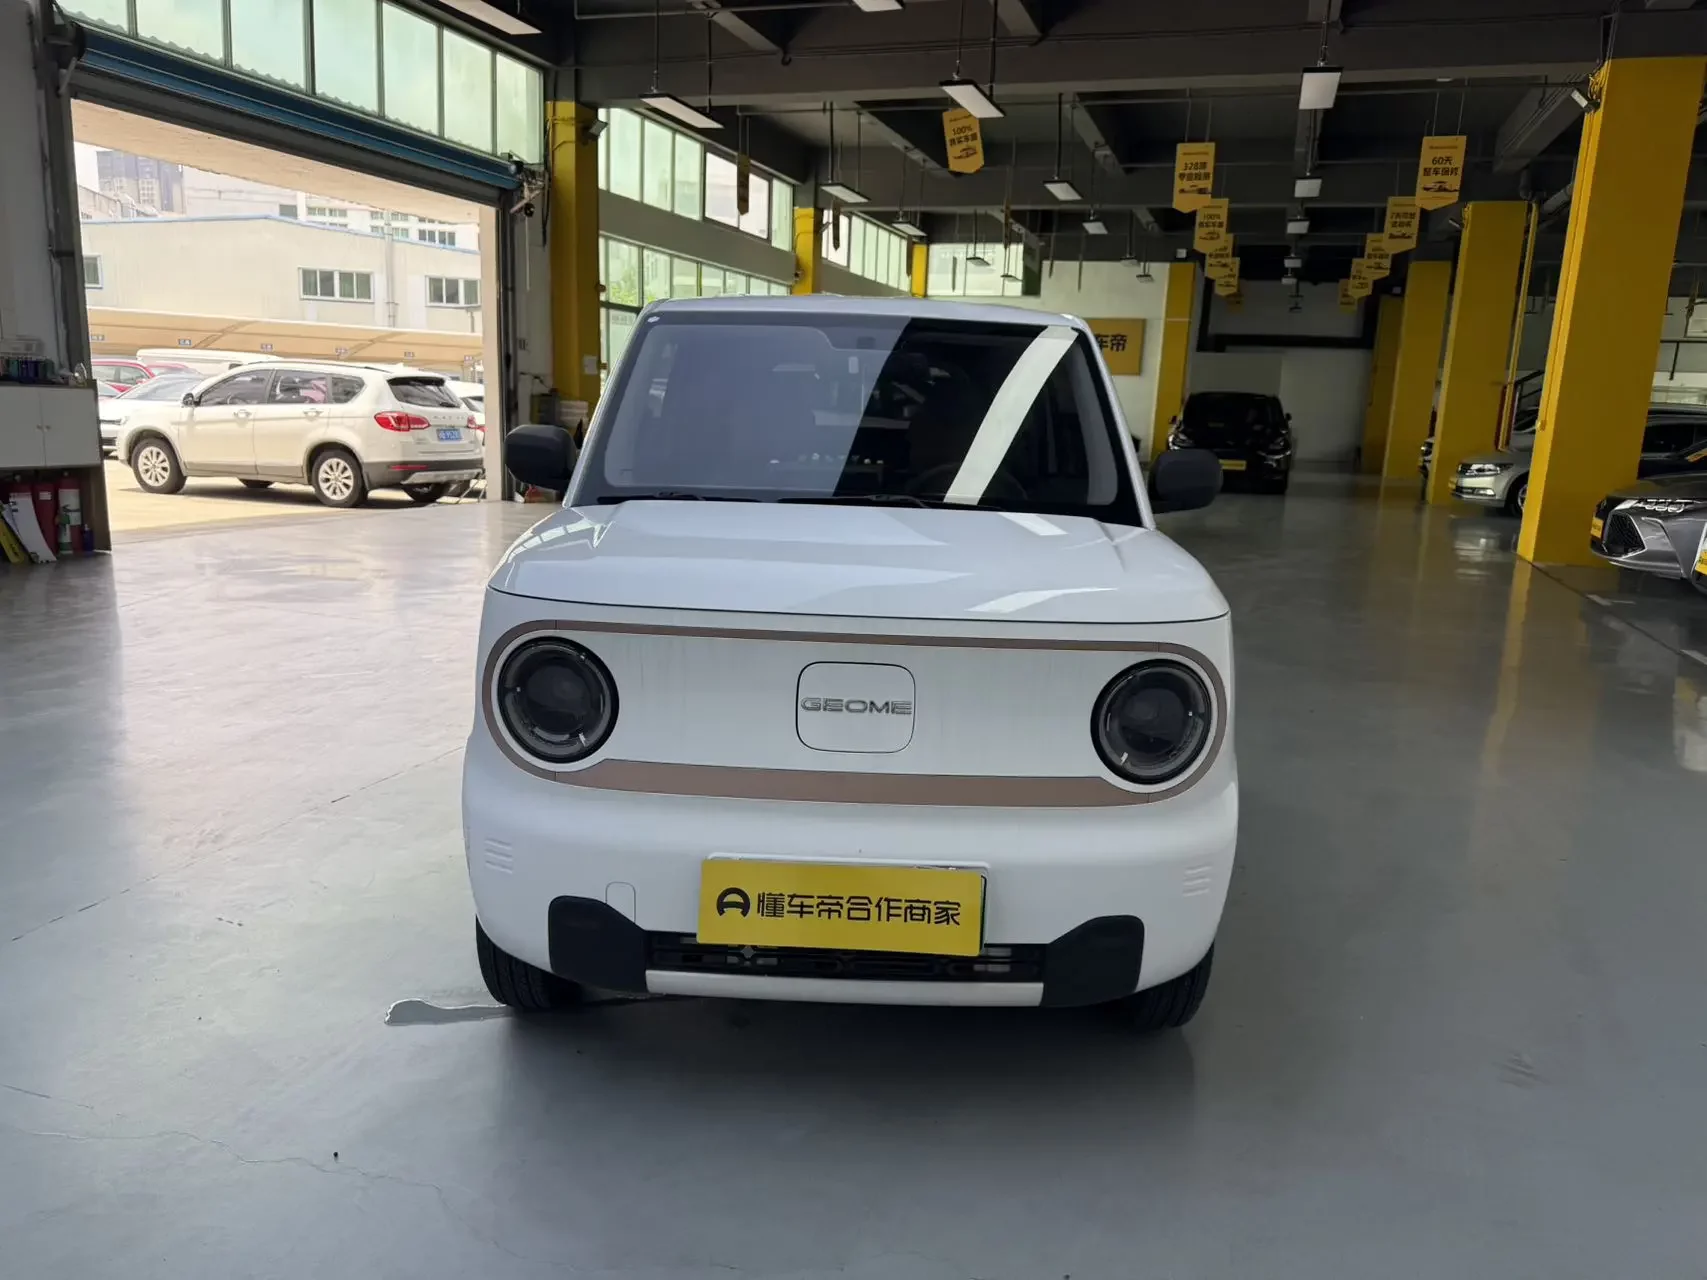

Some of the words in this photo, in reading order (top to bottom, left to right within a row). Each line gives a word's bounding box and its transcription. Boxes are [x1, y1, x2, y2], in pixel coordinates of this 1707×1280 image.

[1431, 156, 1453, 166] 60天
[800, 696, 912, 715] GEOME
[757, 891, 961, 926] 懂车帝合作商家
